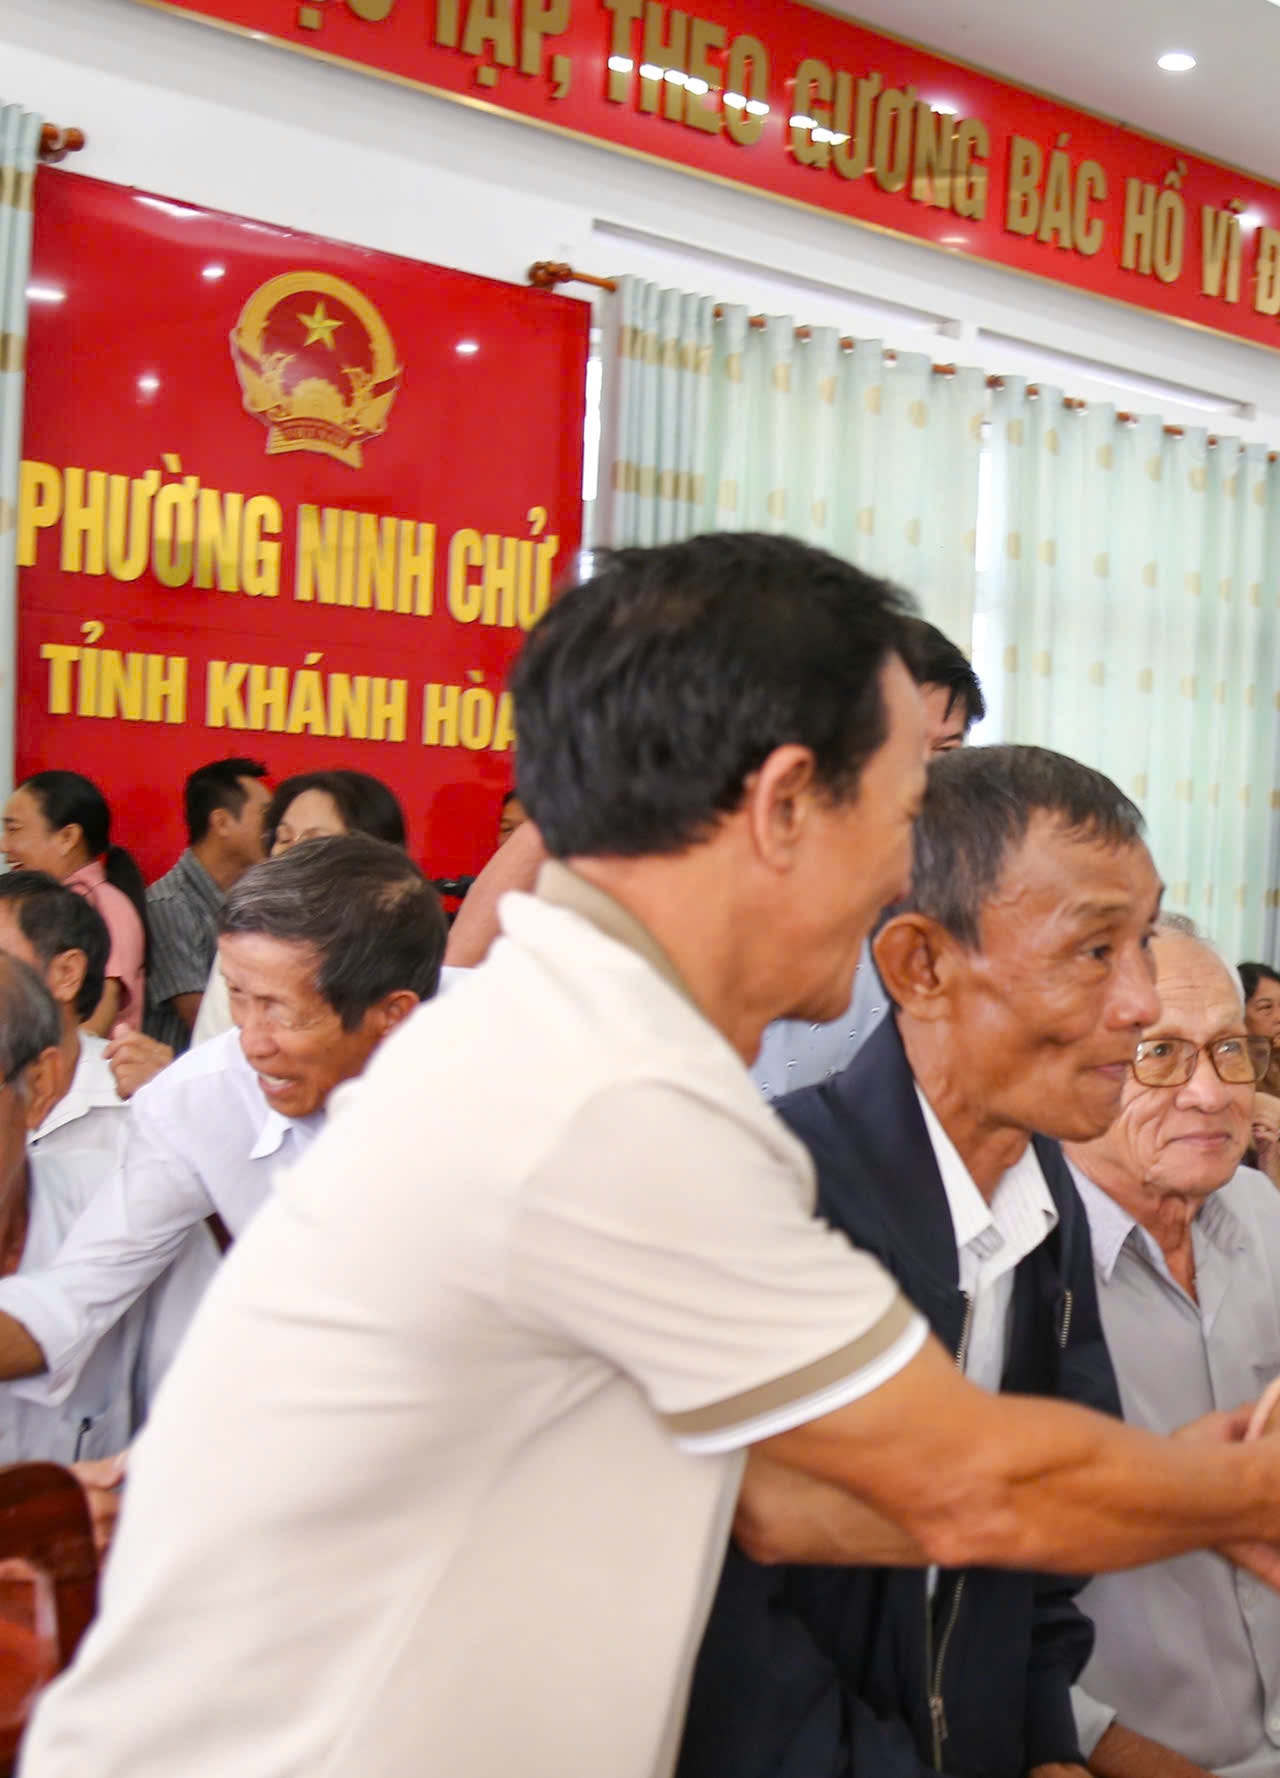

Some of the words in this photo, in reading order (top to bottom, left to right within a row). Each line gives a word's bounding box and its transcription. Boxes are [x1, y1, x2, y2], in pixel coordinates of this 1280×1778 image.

[603, 0, 769, 146] THEO
[791, 57, 990, 222] GƯƠNG
[1005, 133, 1107, 256] BÁC
[1120, 159, 1188, 283] HỒ
[15, 452, 283, 597] PHƯỜNG
[295, 503, 435, 616] NINH
[447, 505, 559, 632] CHỬ
[40, 620, 188, 724] TỈNH
[206, 652, 407, 742] KHÁNH
[422, 670, 519, 752] HÒA
